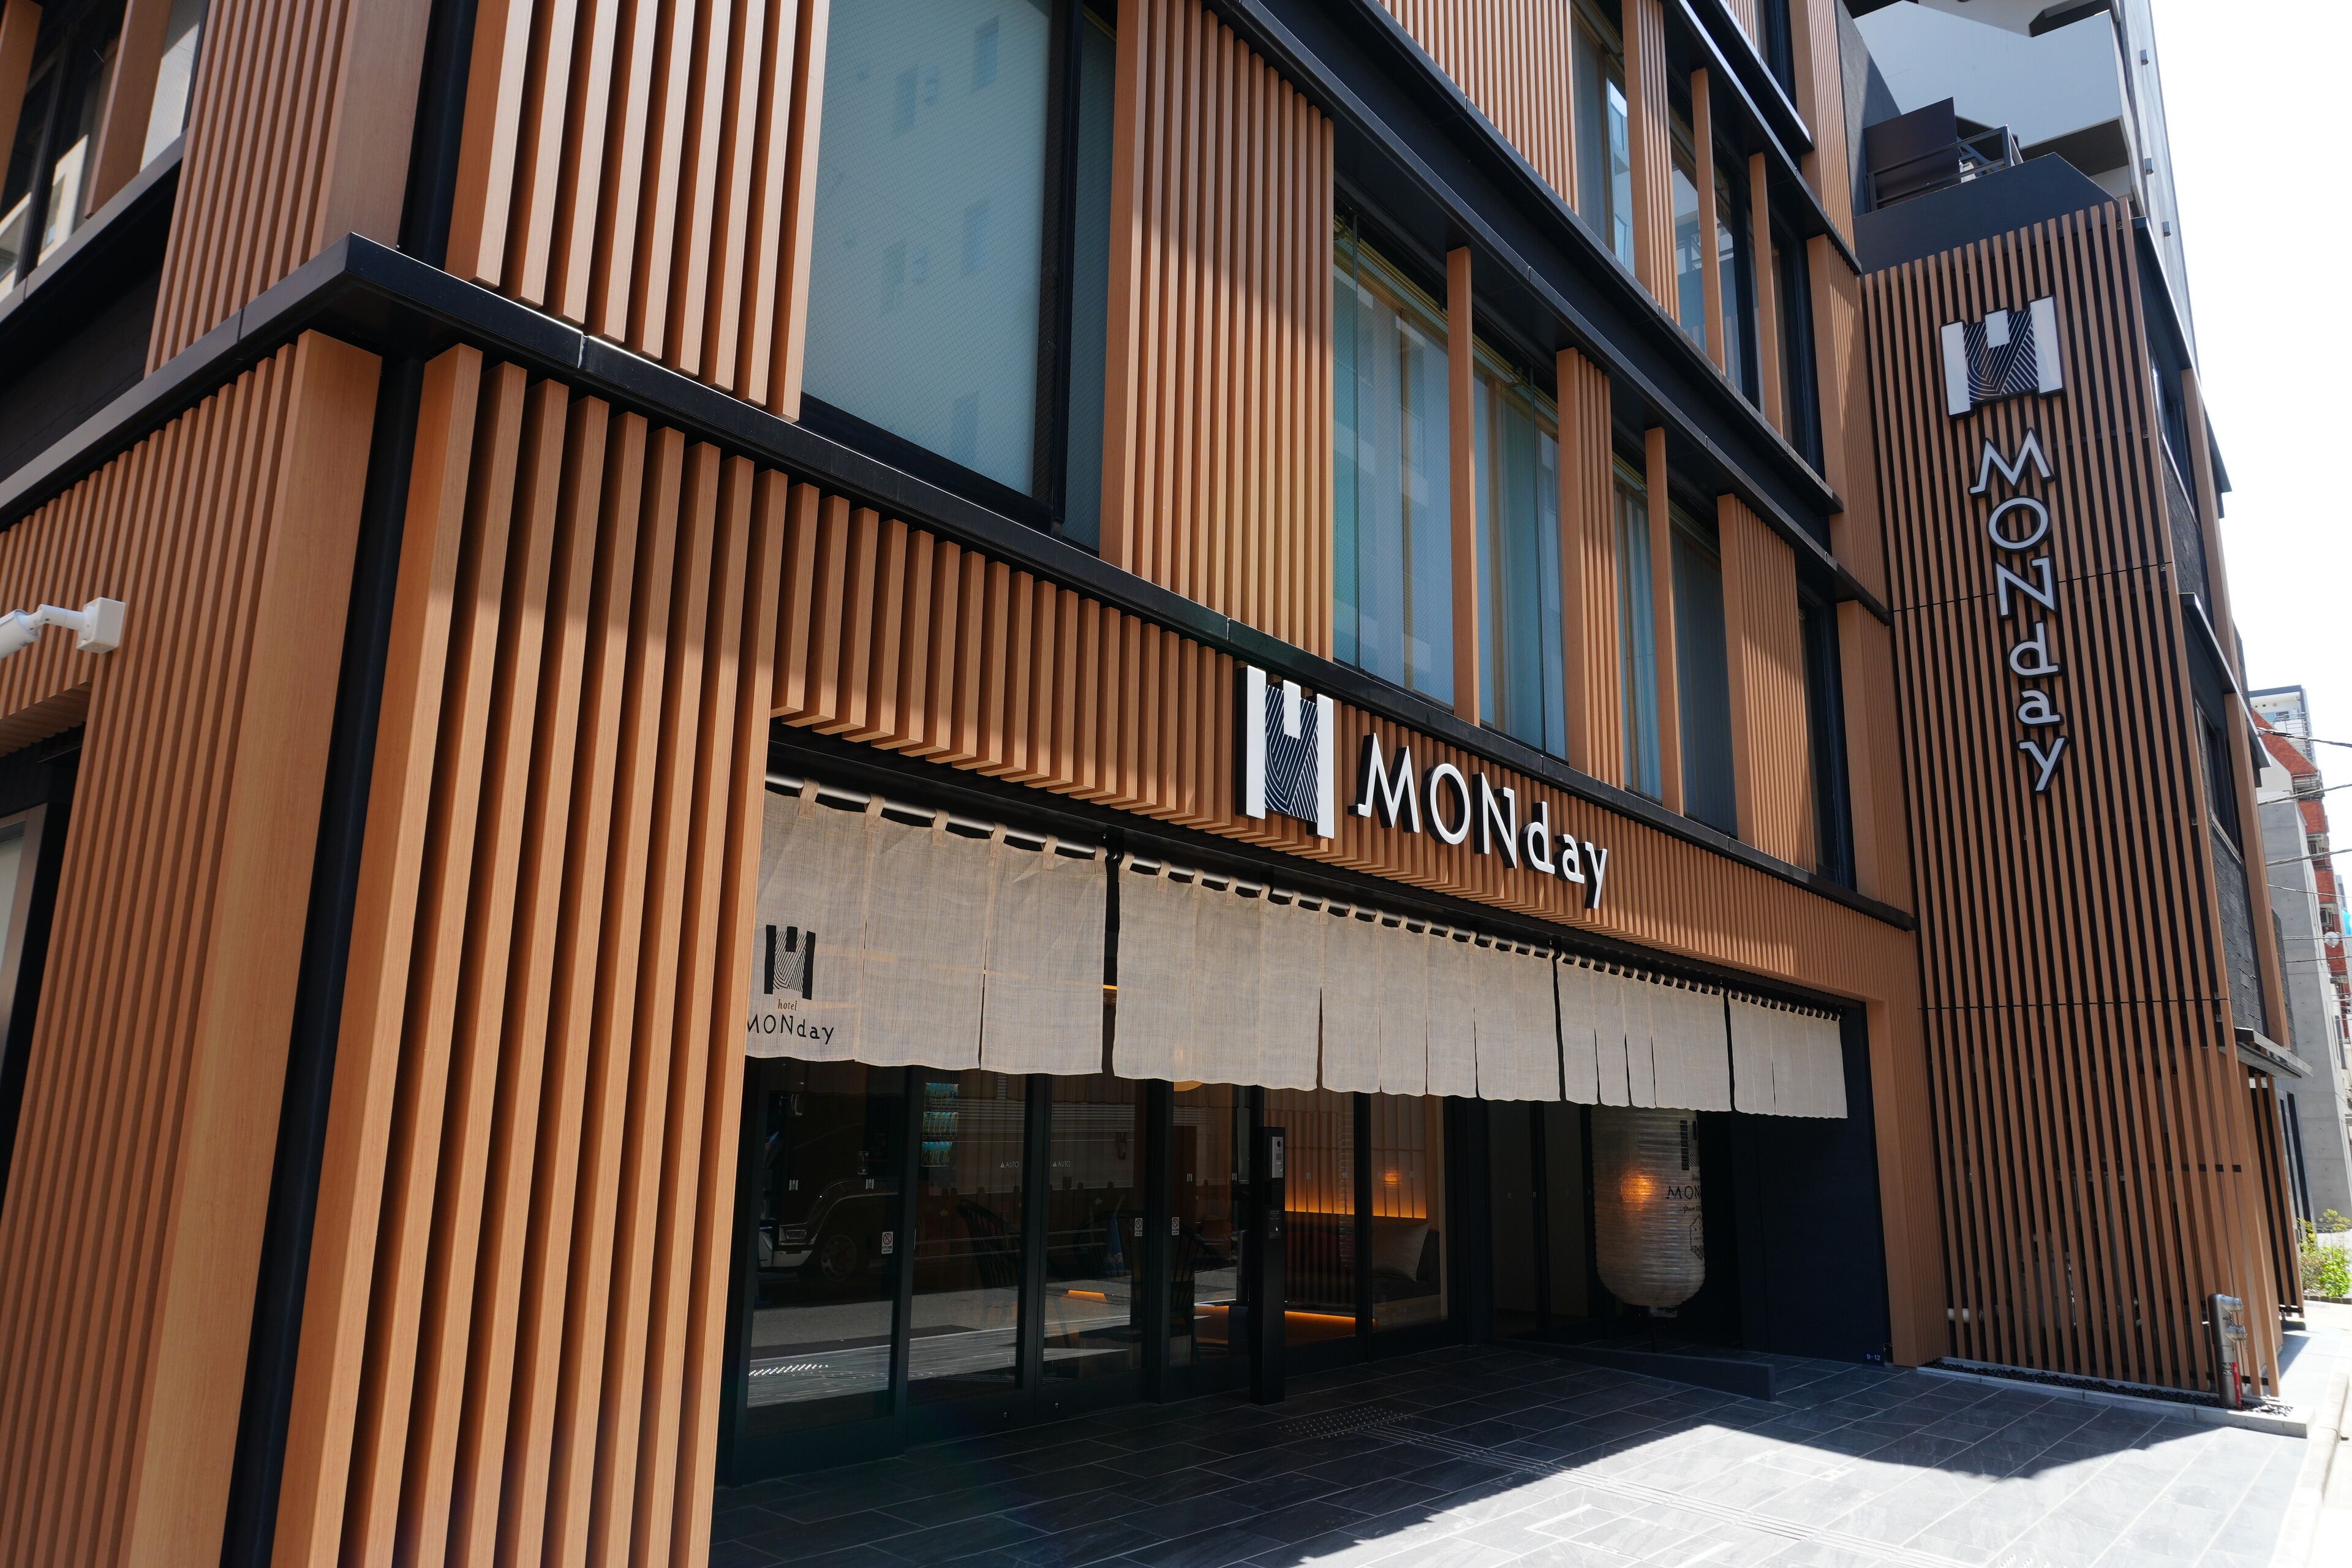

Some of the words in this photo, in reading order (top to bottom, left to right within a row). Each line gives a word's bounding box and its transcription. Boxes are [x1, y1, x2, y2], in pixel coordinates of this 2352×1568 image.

[1969, 428, 2068, 794] MONday
[1356, 732, 1608, 910] MONday
[778, 999, 797, 1011] hotel
